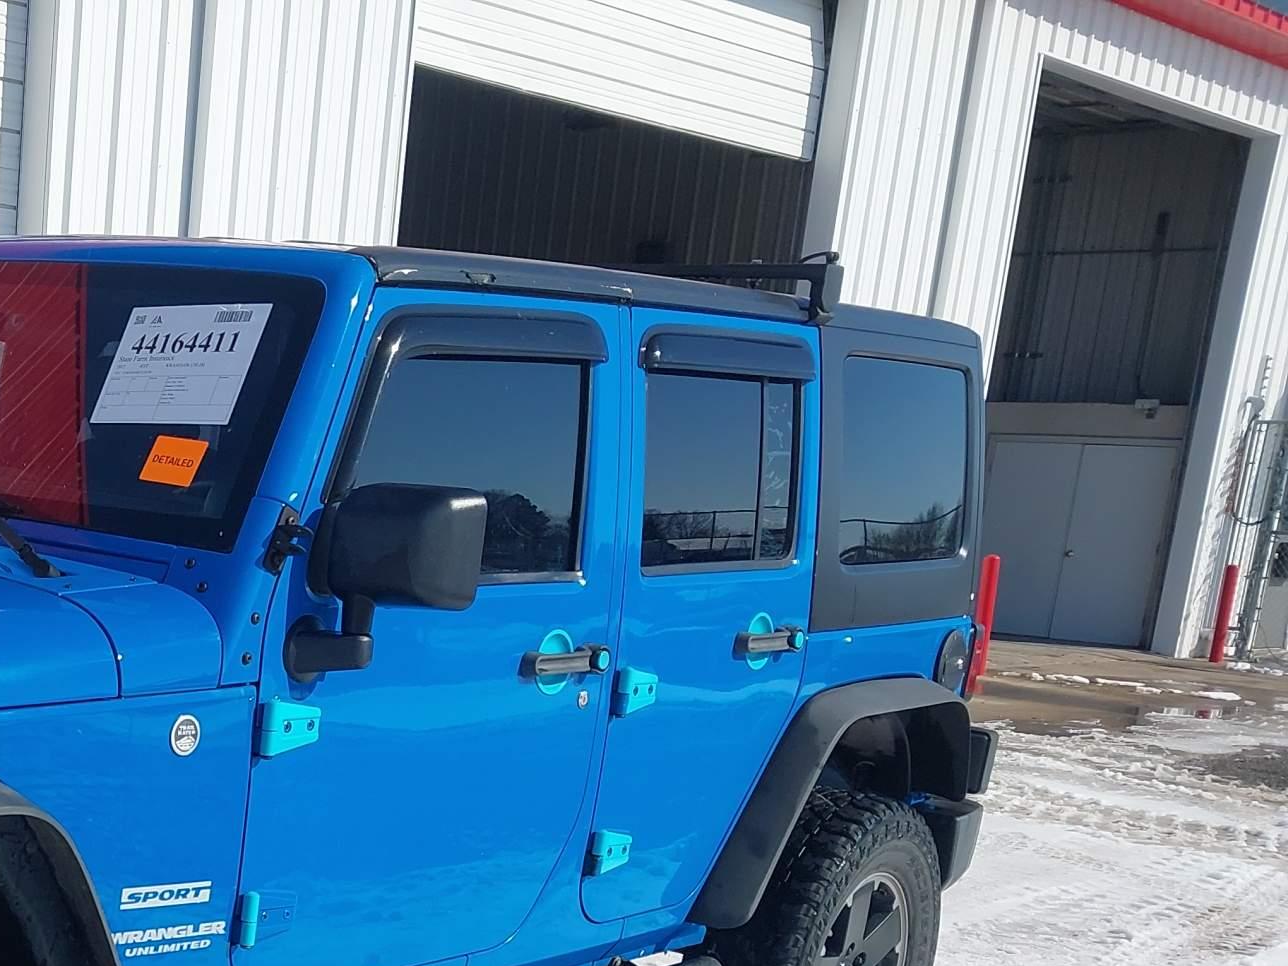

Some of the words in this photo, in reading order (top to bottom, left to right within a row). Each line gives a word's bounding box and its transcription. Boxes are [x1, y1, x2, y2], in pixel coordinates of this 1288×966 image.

[131, 330, 241, 355] 44164411
[151, 454, 194, 468] DETAILED
[123, 886, 206, 905] SPORT
[112, 920, 226, 945] WRANGLER
[124, 939, 211, 957] UNLIMITED
